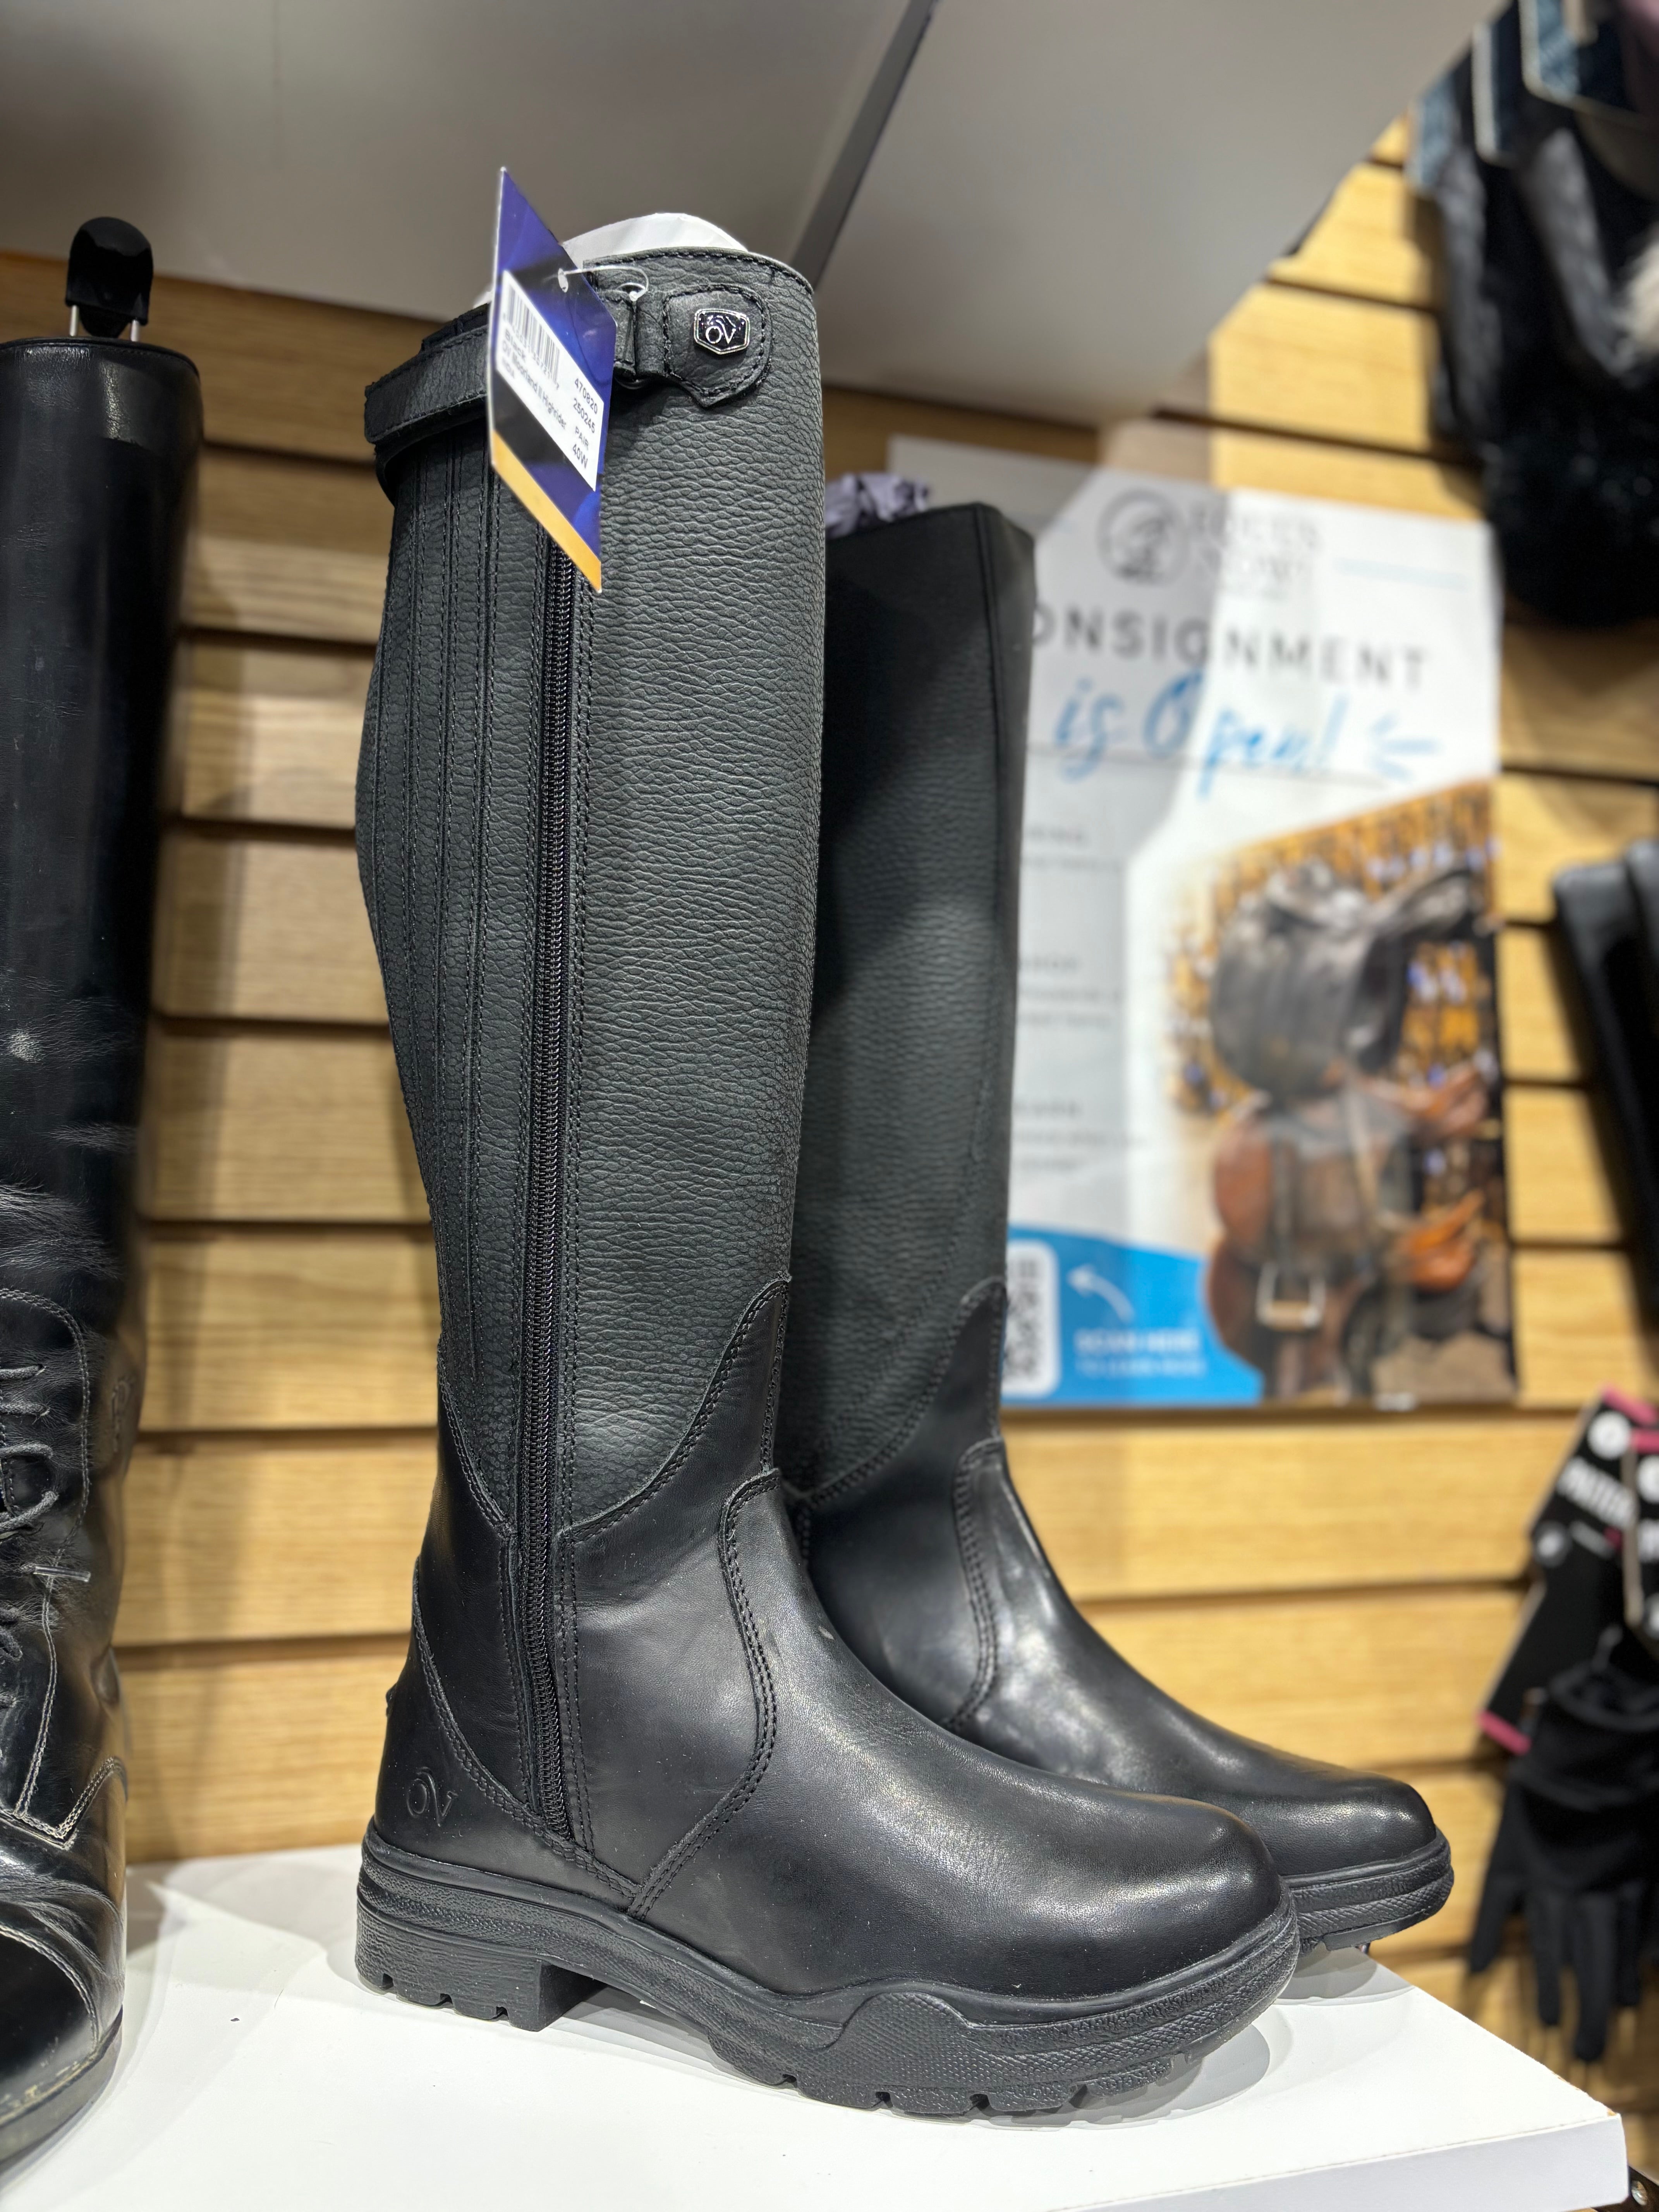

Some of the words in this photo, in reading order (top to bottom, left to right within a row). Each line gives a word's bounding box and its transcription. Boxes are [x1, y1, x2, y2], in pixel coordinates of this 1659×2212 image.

[505, 328, 526, 362] Black
[705, 319, 737, 345] OV
[512, 351, 538, 393] Moorland
[543, 391, 567, 429] Highrider
[575, 378, 598, 415] 470820
[573, 397, 595, 434] 250245
[575, 426, 589, 450] PAIR
[572, 443, 588, 469] 40W
[1032, 601, 1427, 689] ONSIGNMENT
